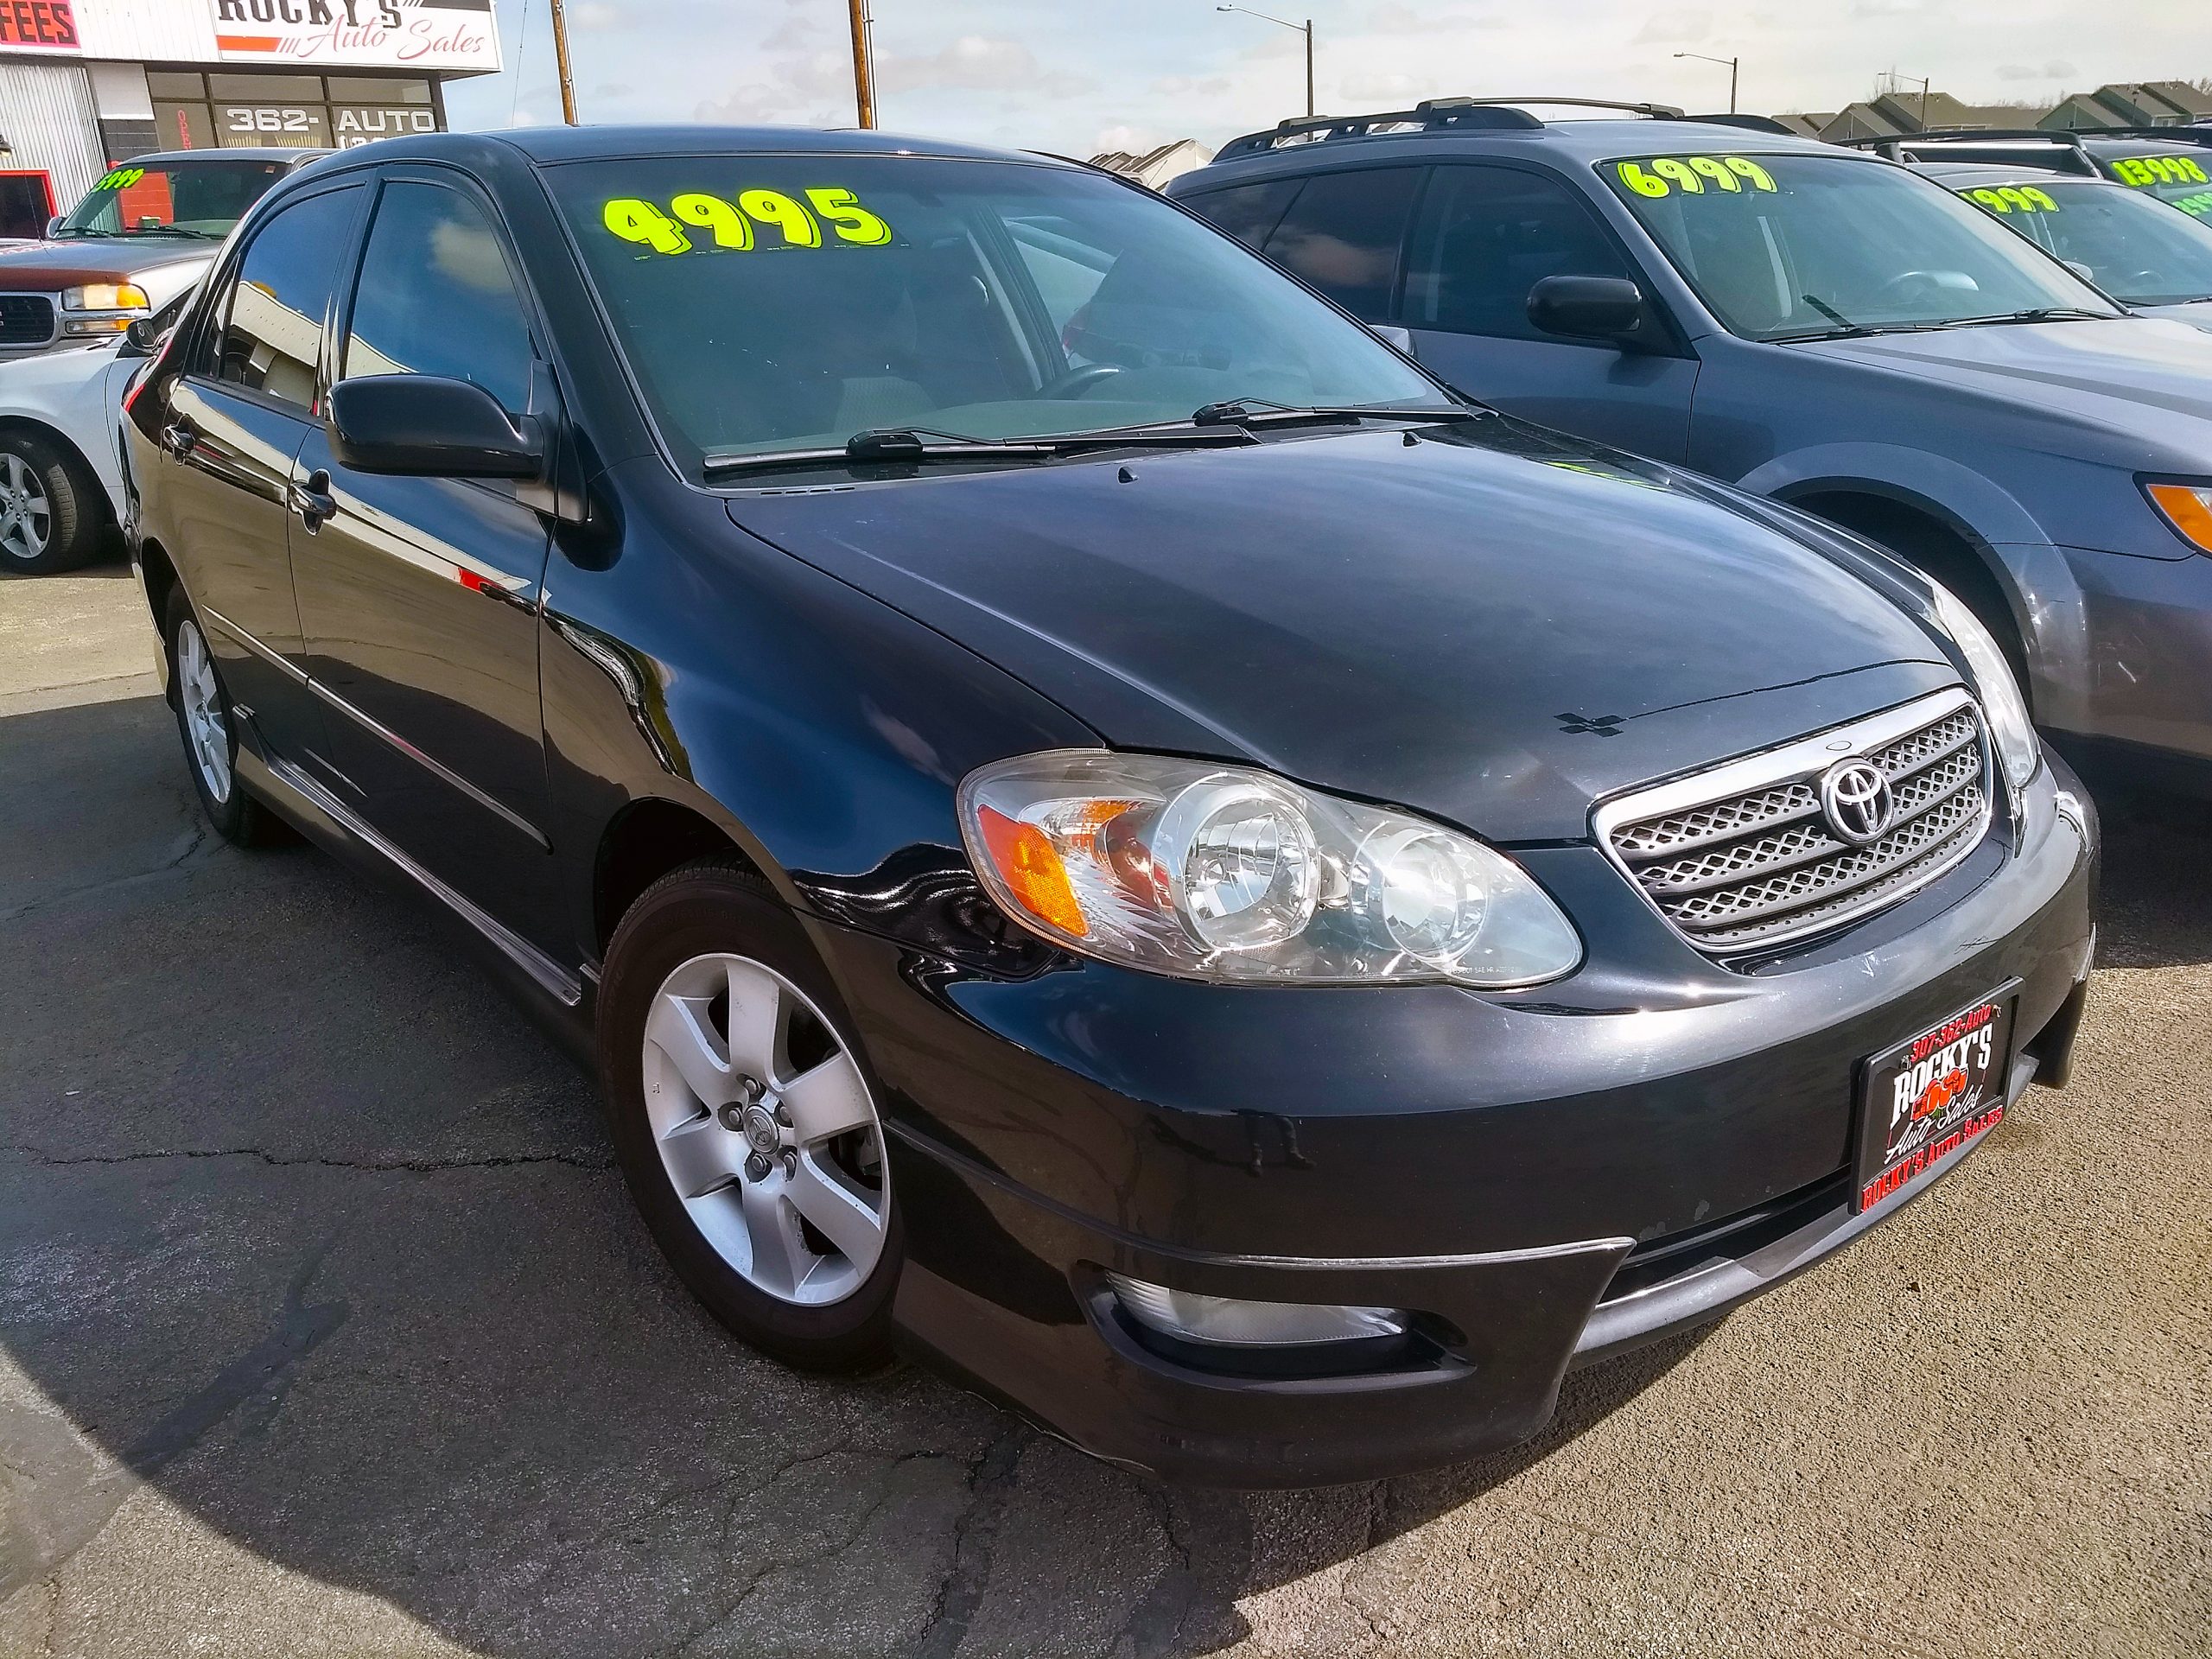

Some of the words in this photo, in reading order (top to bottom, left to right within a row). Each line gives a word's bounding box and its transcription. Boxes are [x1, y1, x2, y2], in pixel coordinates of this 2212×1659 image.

[0, 1, 78, 45] FEES
[218, 0, 402, 29] ROCKYS
[296, 14, 391, 58] Auto
[397, 19, 485, 60] Sales
[226, 108, 320, 131] 362-
[338, 110, 435, 132] AUTO
[1617, 156, 1778, 198] 6999
[2112, 156, 2209, 187] 13998
[603, 187, 893, 256] 4995
[1958, 187, 2060, 213] 999
[1890, 1023, 1993, 1131] ROCKY'S
[1884, 1116, 1936, 1166] Auto
[1936, 1084, 1984, 1130] Sales
